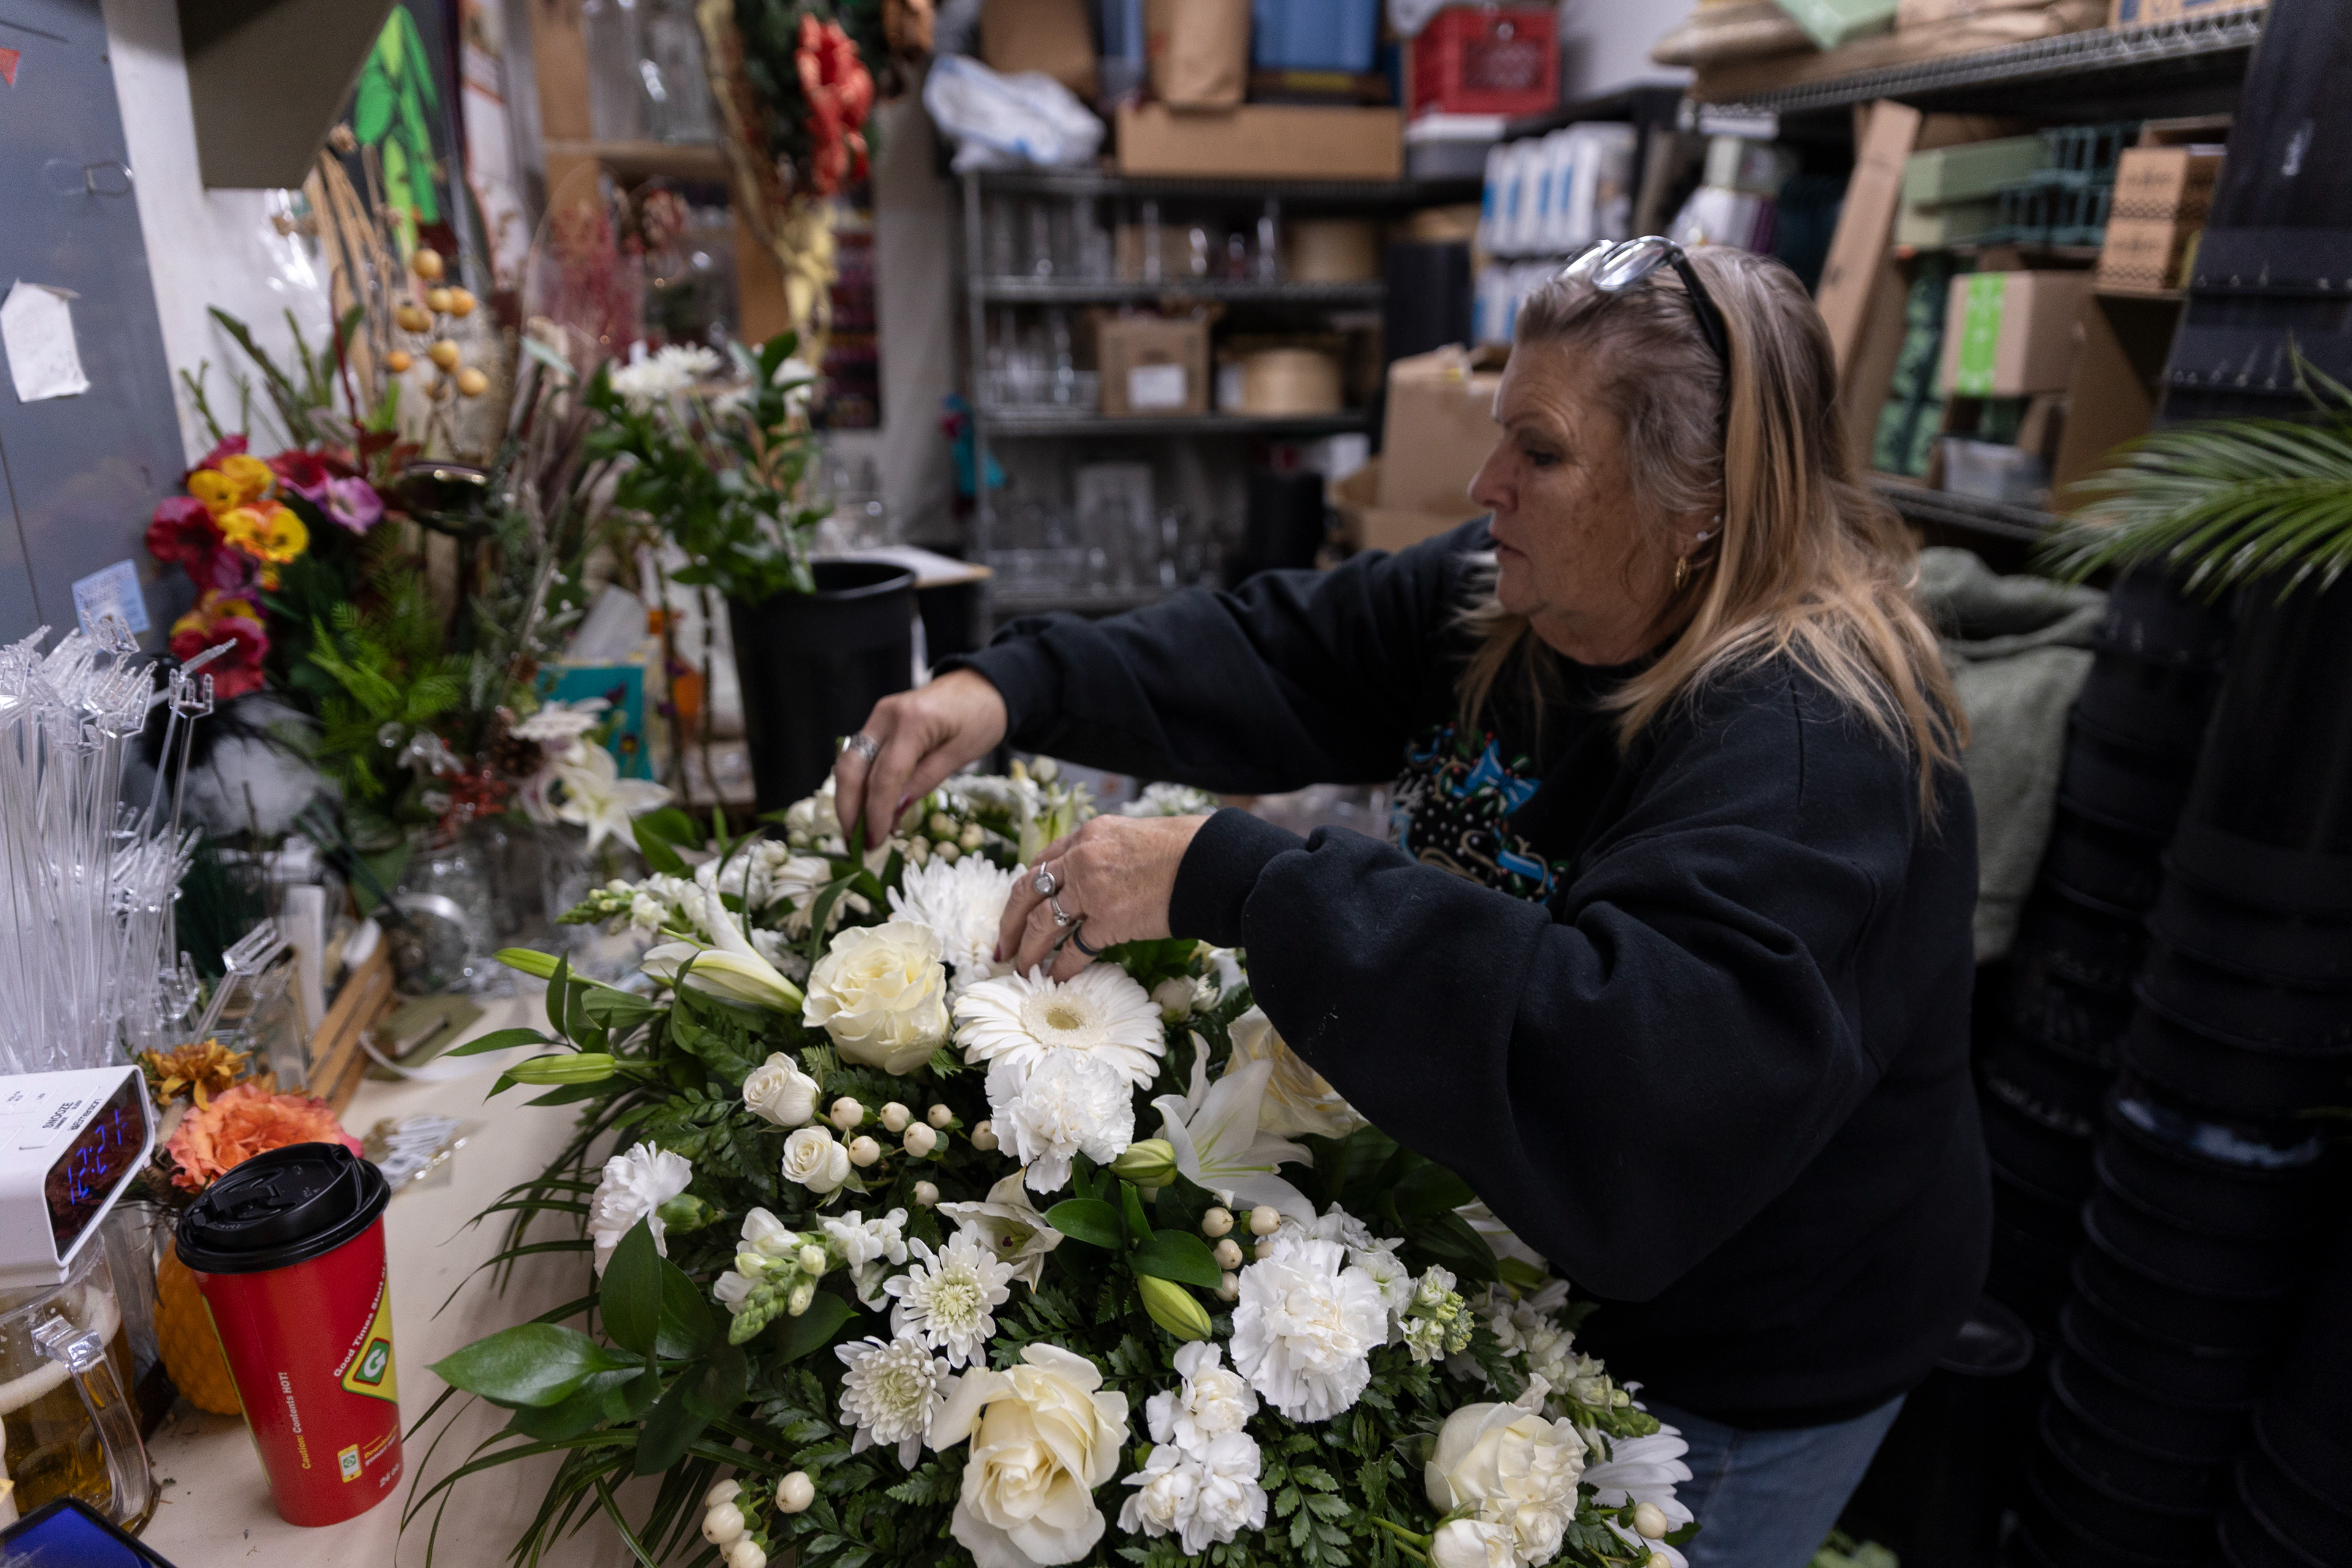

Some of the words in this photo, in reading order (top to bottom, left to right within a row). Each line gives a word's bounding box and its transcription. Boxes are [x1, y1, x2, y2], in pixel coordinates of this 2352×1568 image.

[42, 1102, 74, 1129] SNOOZE
[333, 1349, 355, 1377] Good
[352, 1313, 374, 1346] Times
[371, 1281, 383, 1311] Start
[277, 1371, 292, 1393] HOT!
[286, 1395, 301, 1434] Contents
[296, 1434, 311, 1469] Caution:
